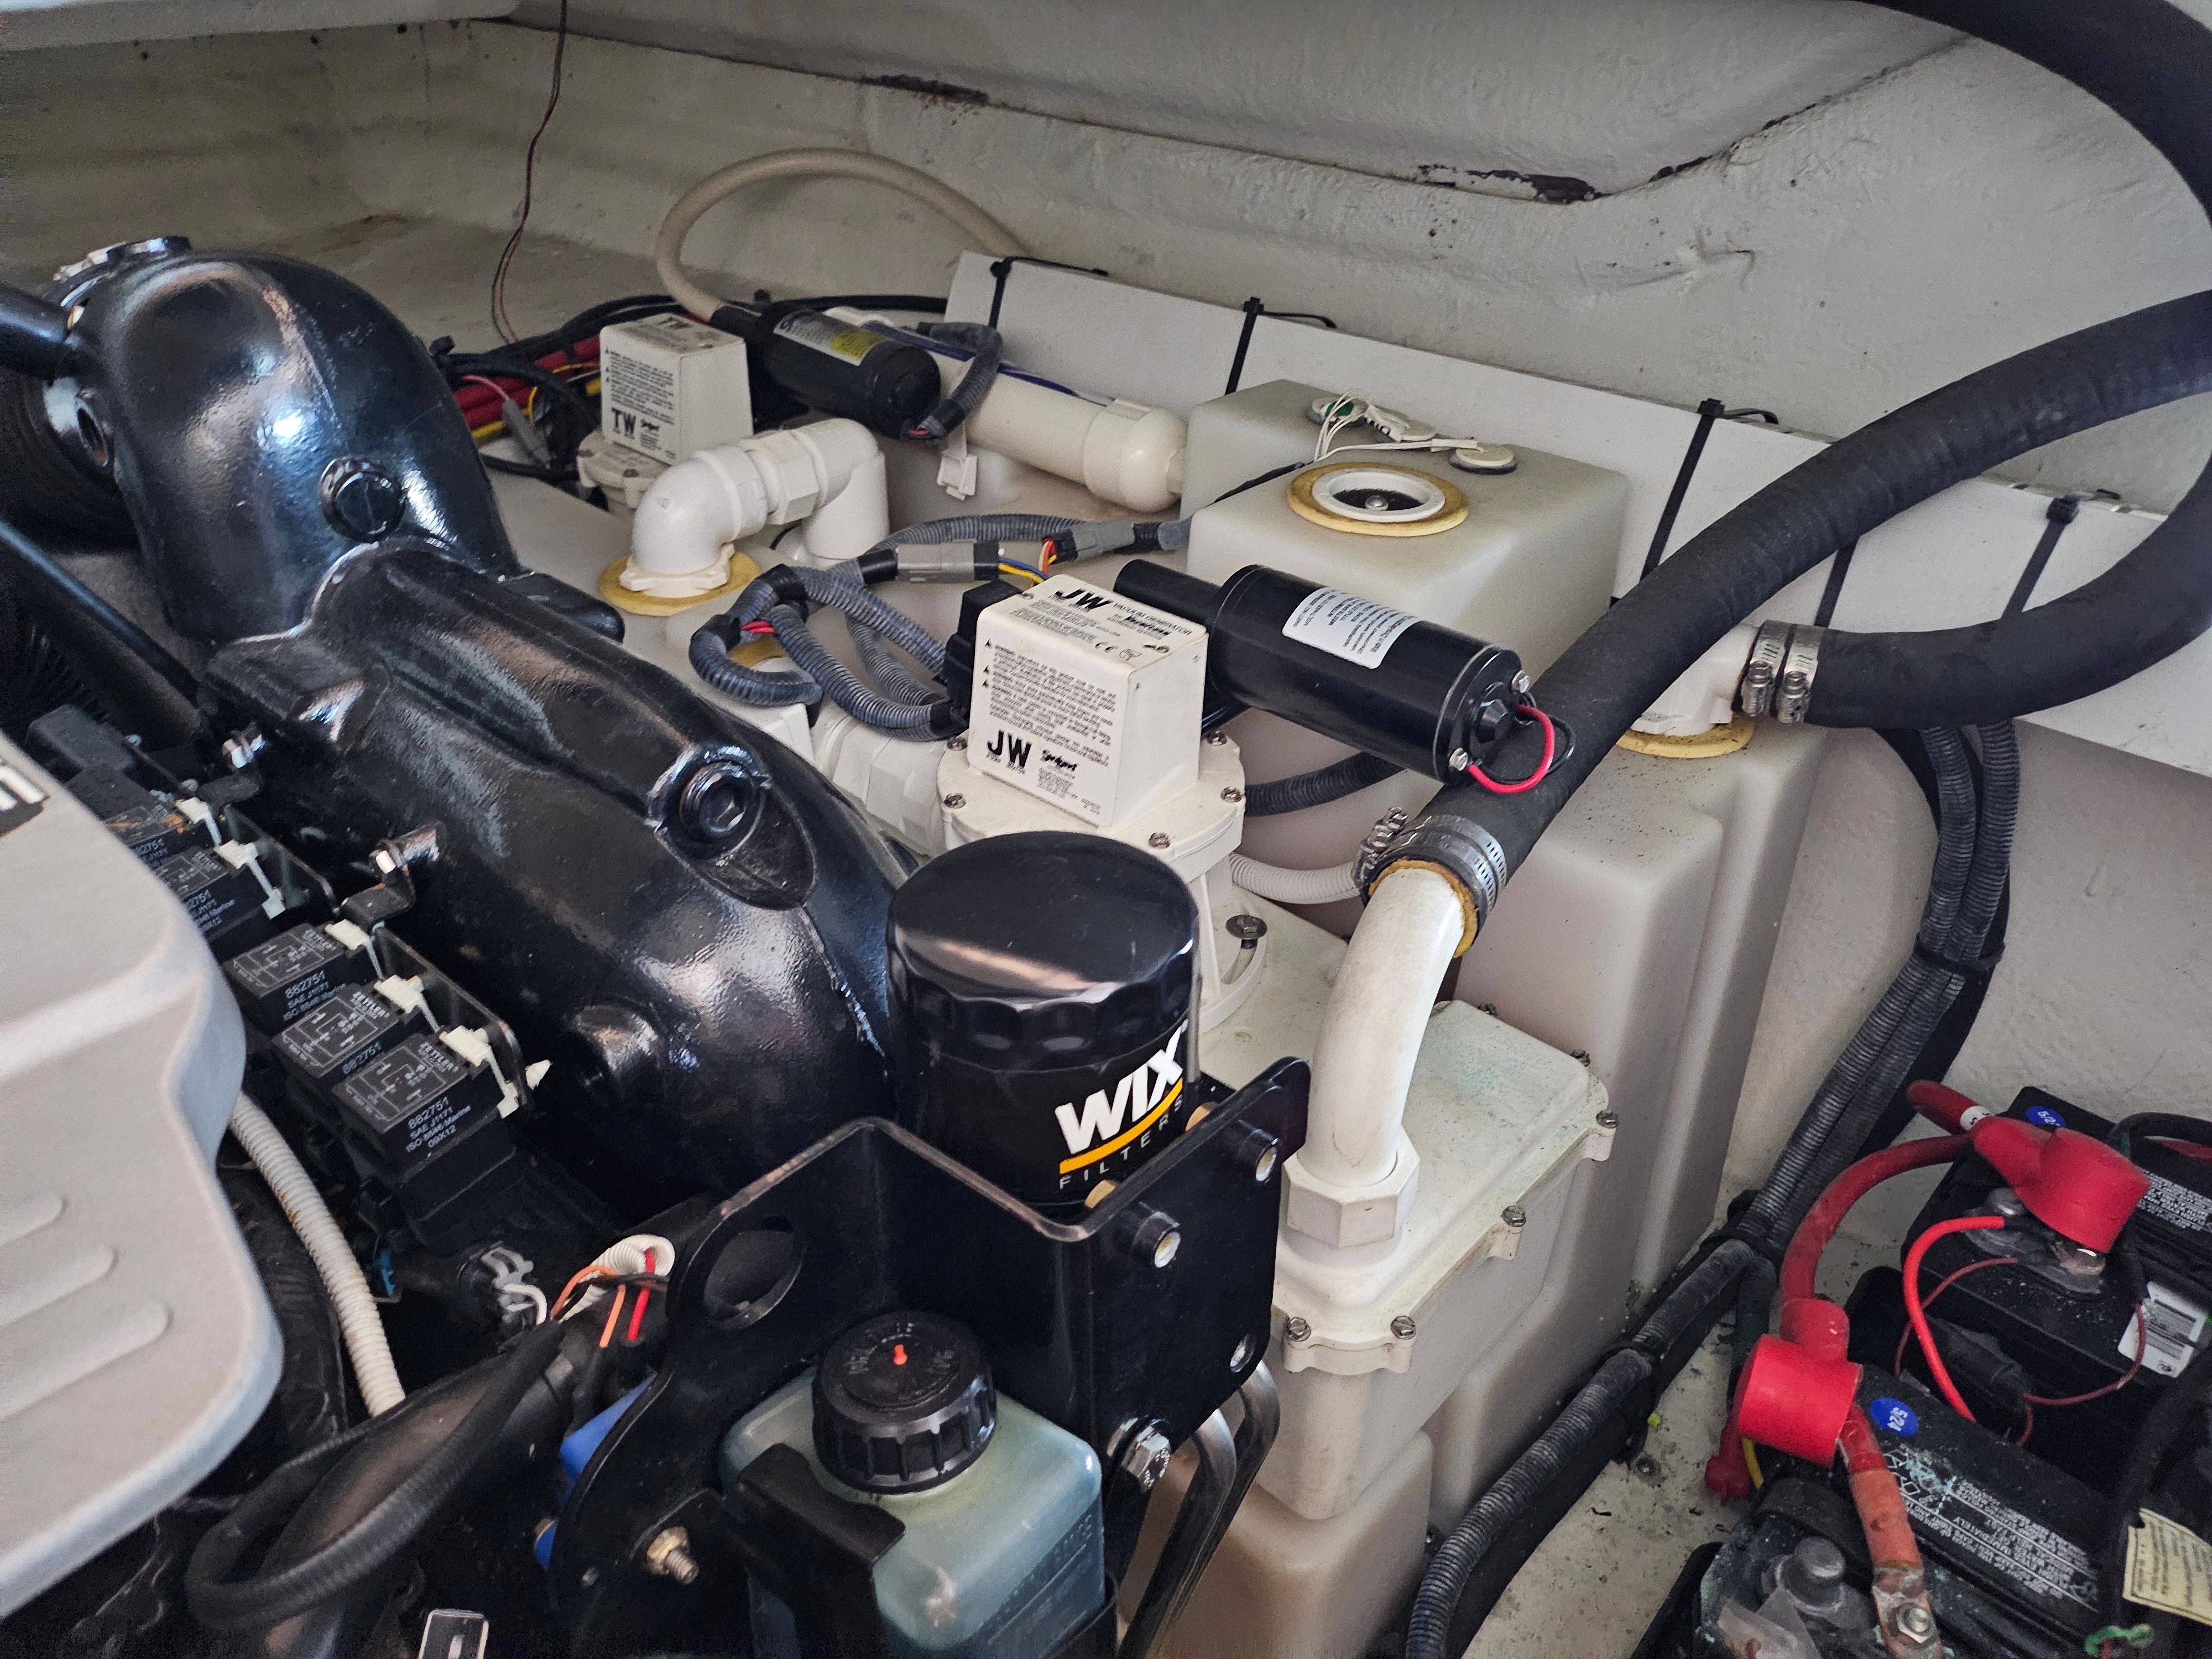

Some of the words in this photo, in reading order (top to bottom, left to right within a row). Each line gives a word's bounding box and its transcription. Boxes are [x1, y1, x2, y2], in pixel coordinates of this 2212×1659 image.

[611, 407, 636, 440] TW
[1055, 588, 1114, 610] JW
[987, 729, 1032, 768] JW
[285, 970, 326, 999] 882751
[342, 1042, 382, 1074] 882751
[1055, 1025, 1183, 1155] WIX
[408, 1097, 448, 1129] 882751
[1060, 1094, 1183, 1189] FILTERS
[1887, 1407, 1908, 1432] 5/24
